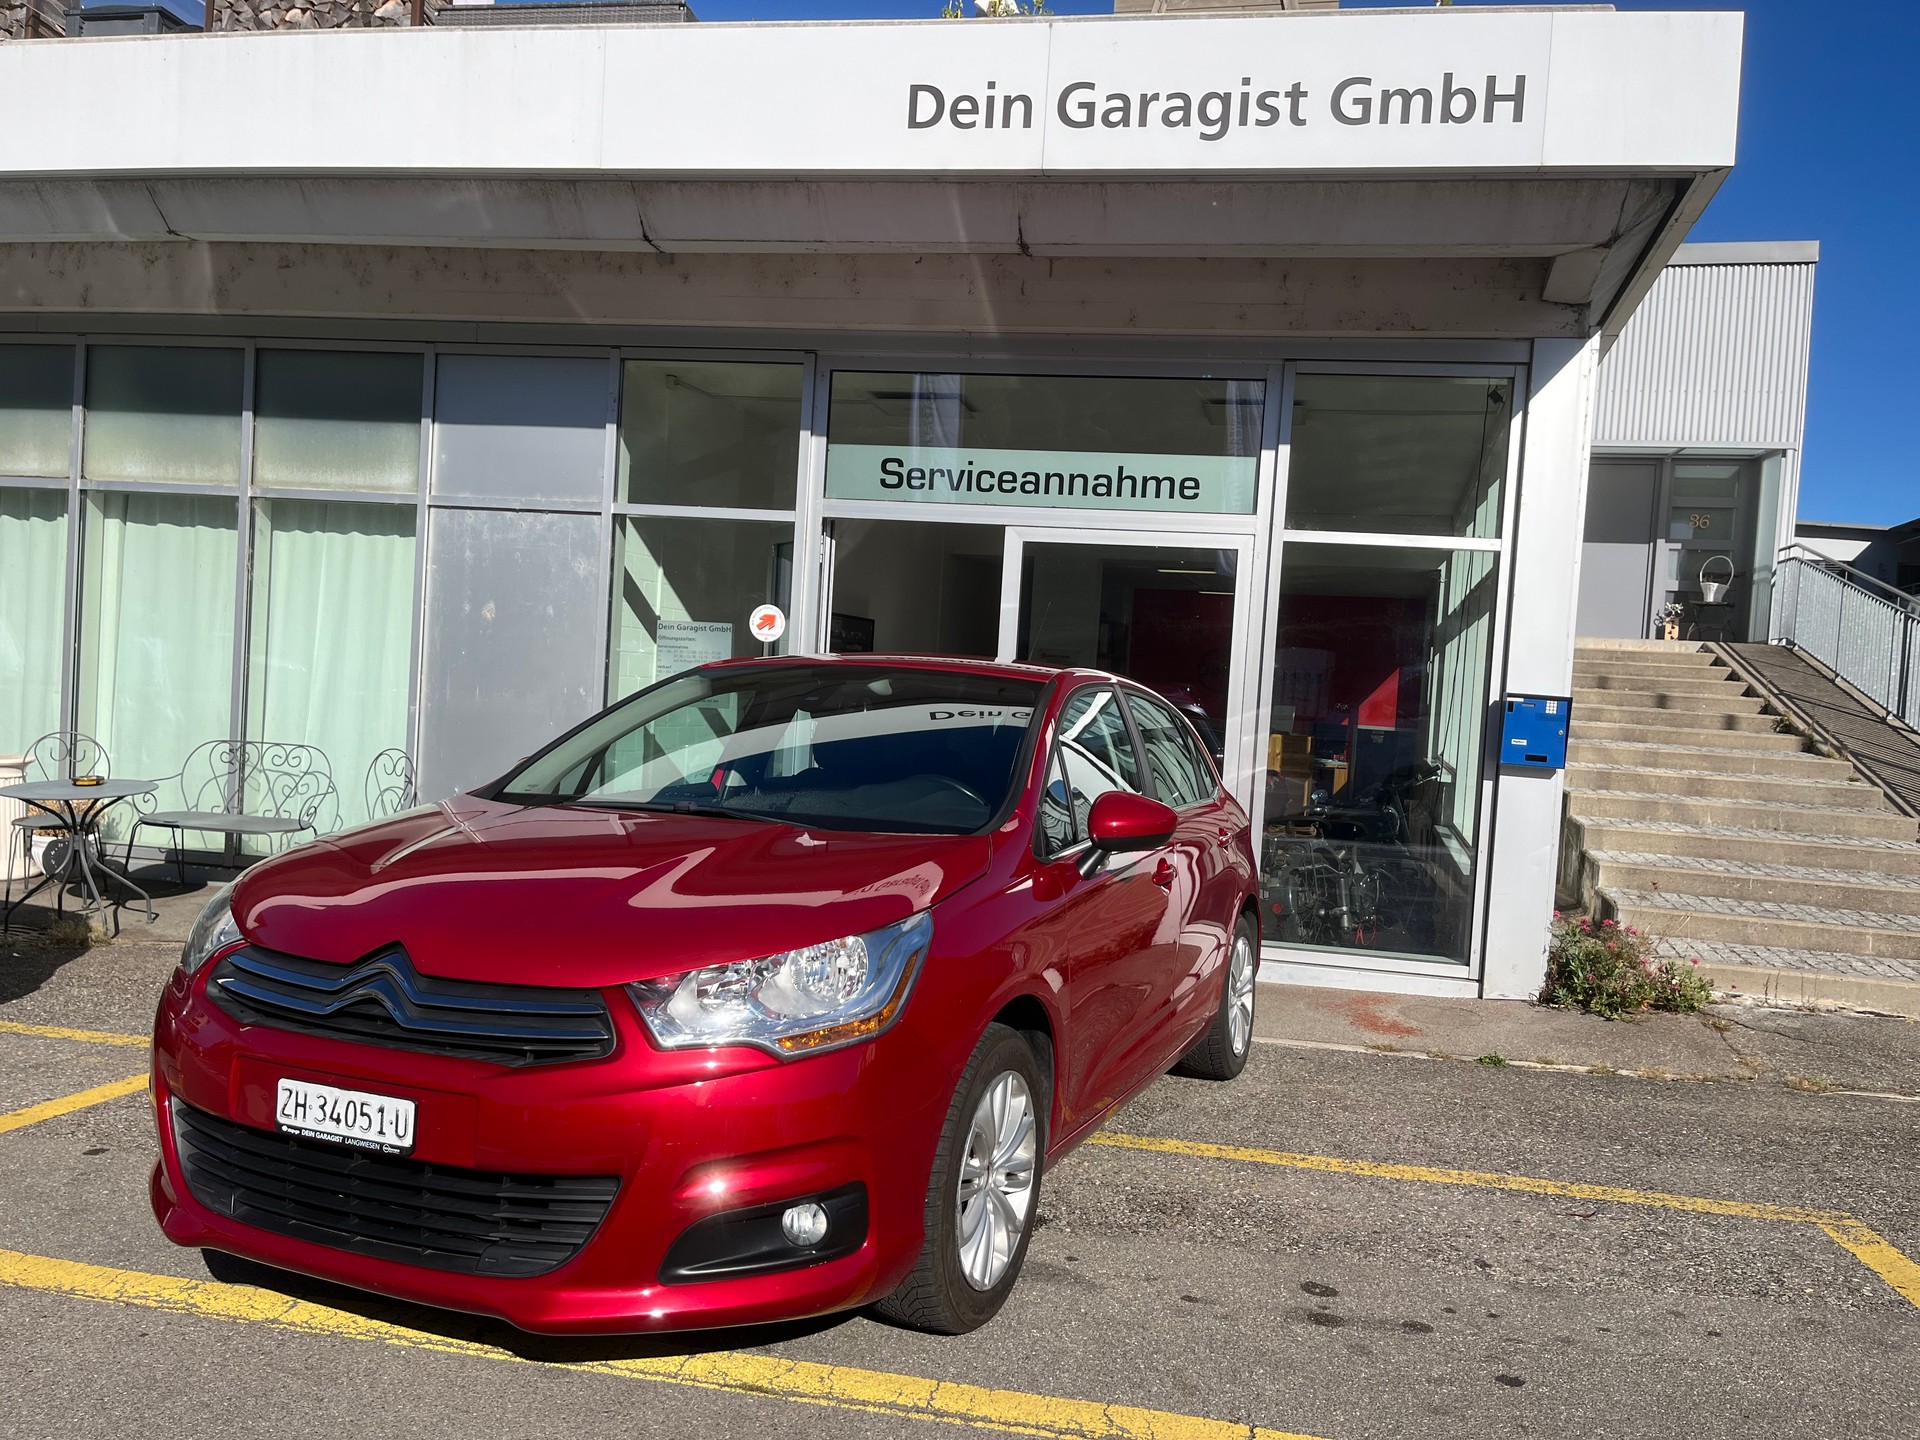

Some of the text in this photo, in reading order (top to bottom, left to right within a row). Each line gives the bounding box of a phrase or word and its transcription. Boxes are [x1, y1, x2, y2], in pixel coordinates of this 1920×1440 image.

[907, 72, 1527, 141] Dein Garagist GmbH
[879, 457, 1201, 500] Serviceannahme
[1689, 513, 1711, 529] 36
[658, 623, 732, 633] Dein Garagist GmbH
[301, 1128, 315, 1138] DEIN
[315, 1131, 344, 1143] GARAGIST
[344, 1137, 380, 1150] LANGWIESEN
